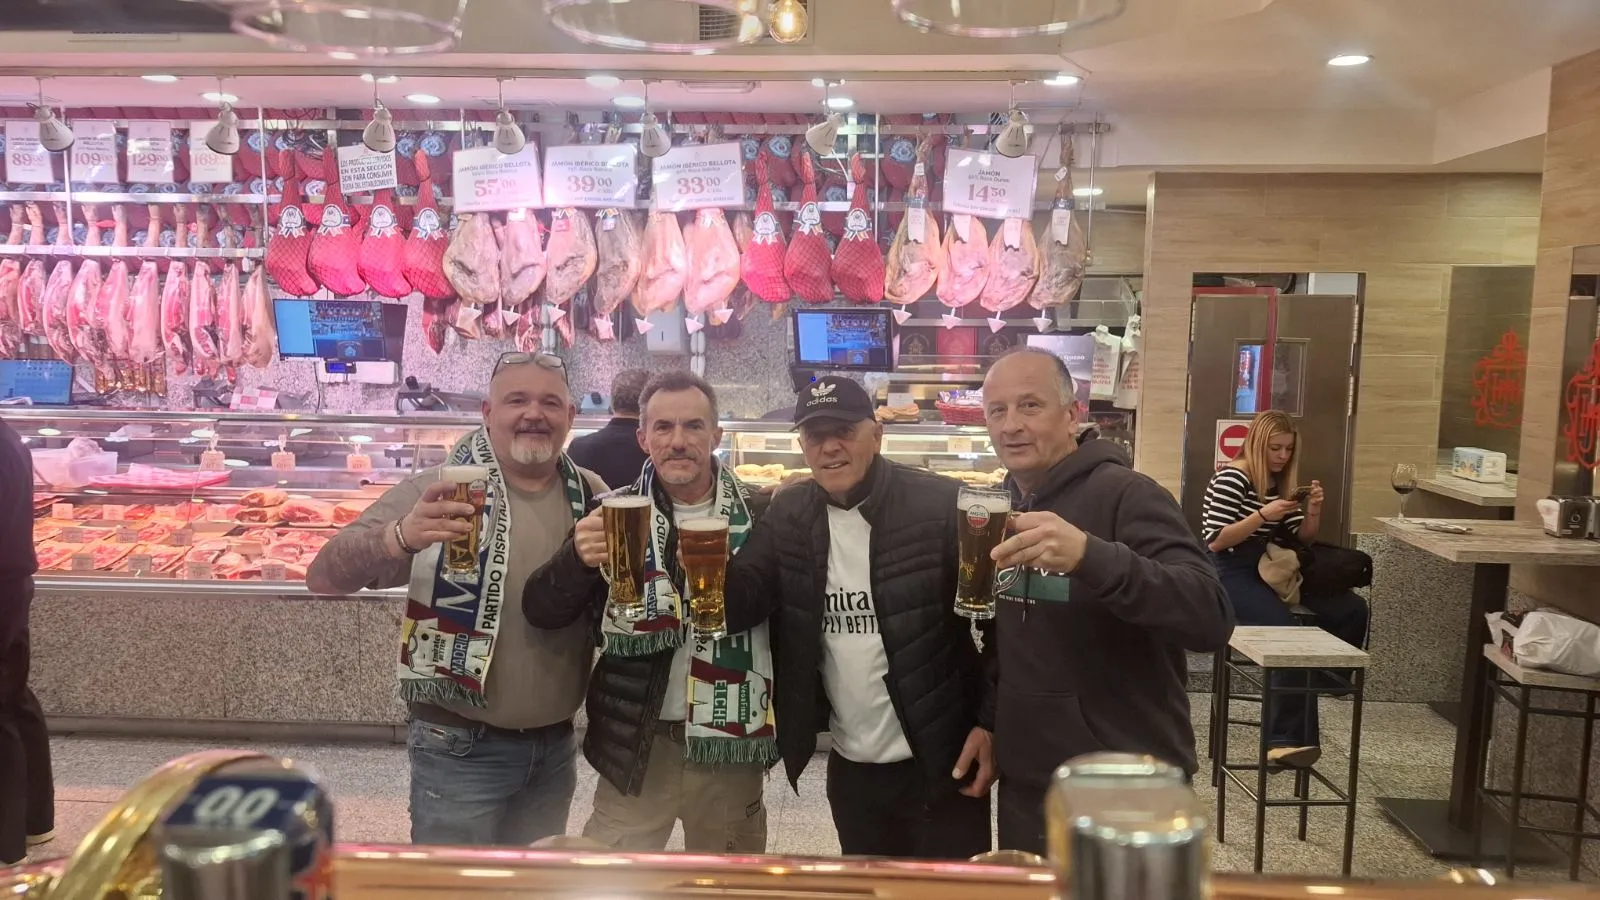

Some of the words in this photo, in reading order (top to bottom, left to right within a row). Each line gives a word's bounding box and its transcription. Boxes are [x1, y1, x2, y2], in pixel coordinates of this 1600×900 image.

[350, 166, 366, 174] ESTA
[366, 163, 393, 172] SECCIÓN
[600, 160, 630, 168] BEOTA
[708, 159, 737, 167] BELLOTA
[341, 174, 352, 182] SON
[353, 173, 366, 181] PARA
[366, 170, 393, 179] CONSUMIR
[806, 395, 838, 407] adidas
[476, 434, 494, 464] MAD
[720, 504, 731, 516] 14
[482, 570, 502, 630] PARTIDO
[824, 586, 871, 613] mira
[824, 615, 842, 634] FLY
[845, 614, 881, 635] BETT
[432, 634, 441, 663] Emirates
[451, 632, 469, 676] MADRID
[714, 679, 728, 727] ELCHE
